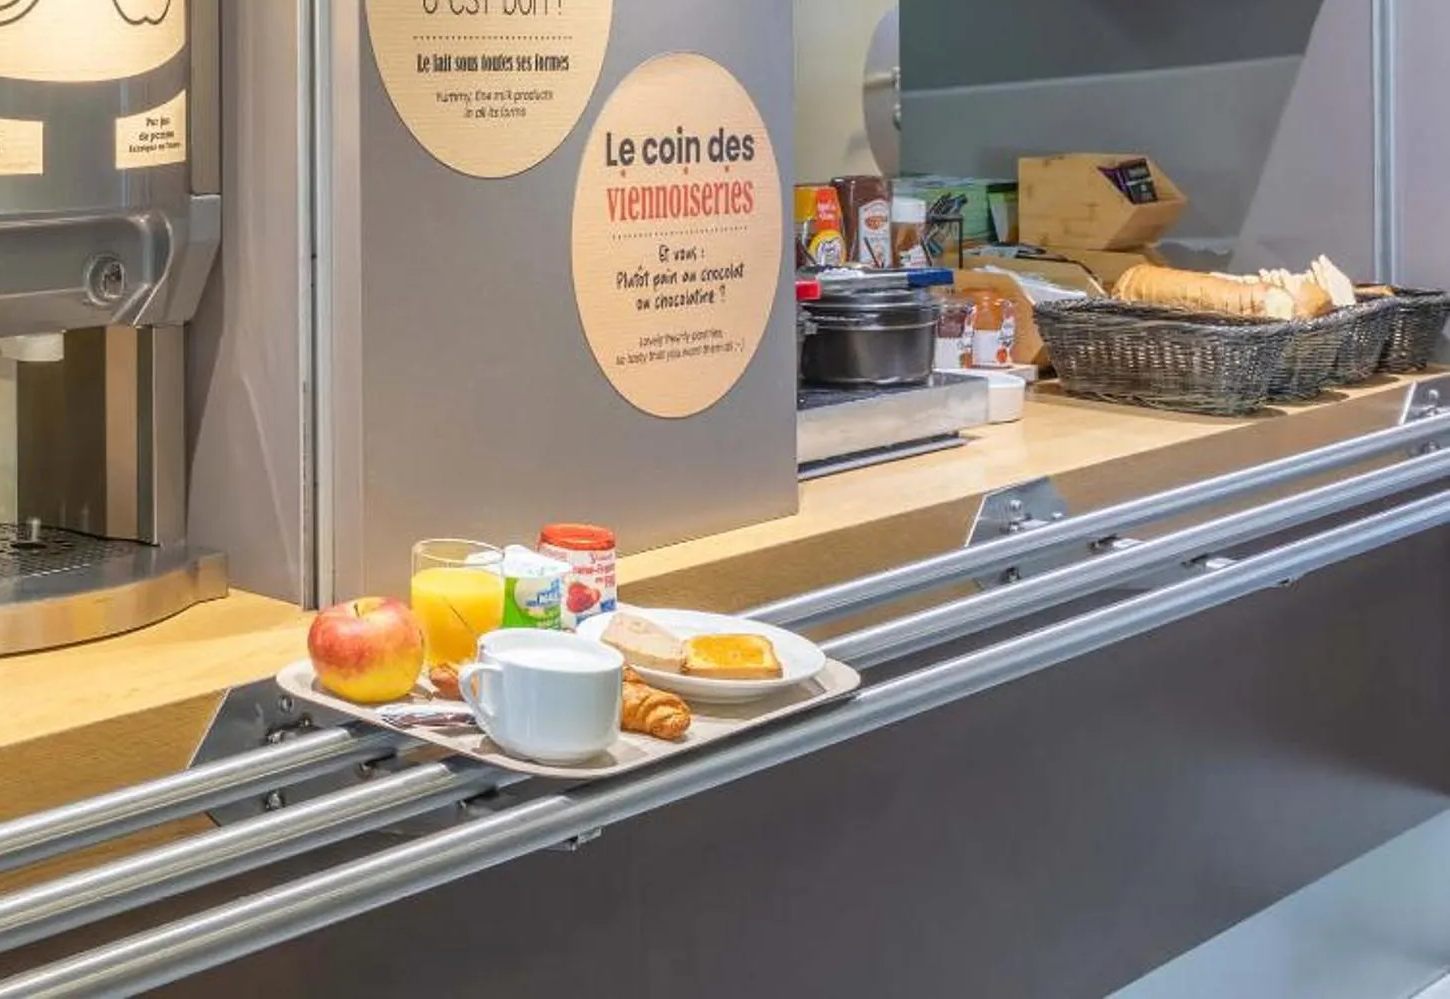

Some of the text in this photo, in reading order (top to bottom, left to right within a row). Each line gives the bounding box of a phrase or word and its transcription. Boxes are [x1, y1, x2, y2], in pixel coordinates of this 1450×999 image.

[417, 53, 570, 73] Le lait sous toutes ses formes
[606, 125, 755, 166] Le coin des
[606, 165, 754, 222] viennoiseries
